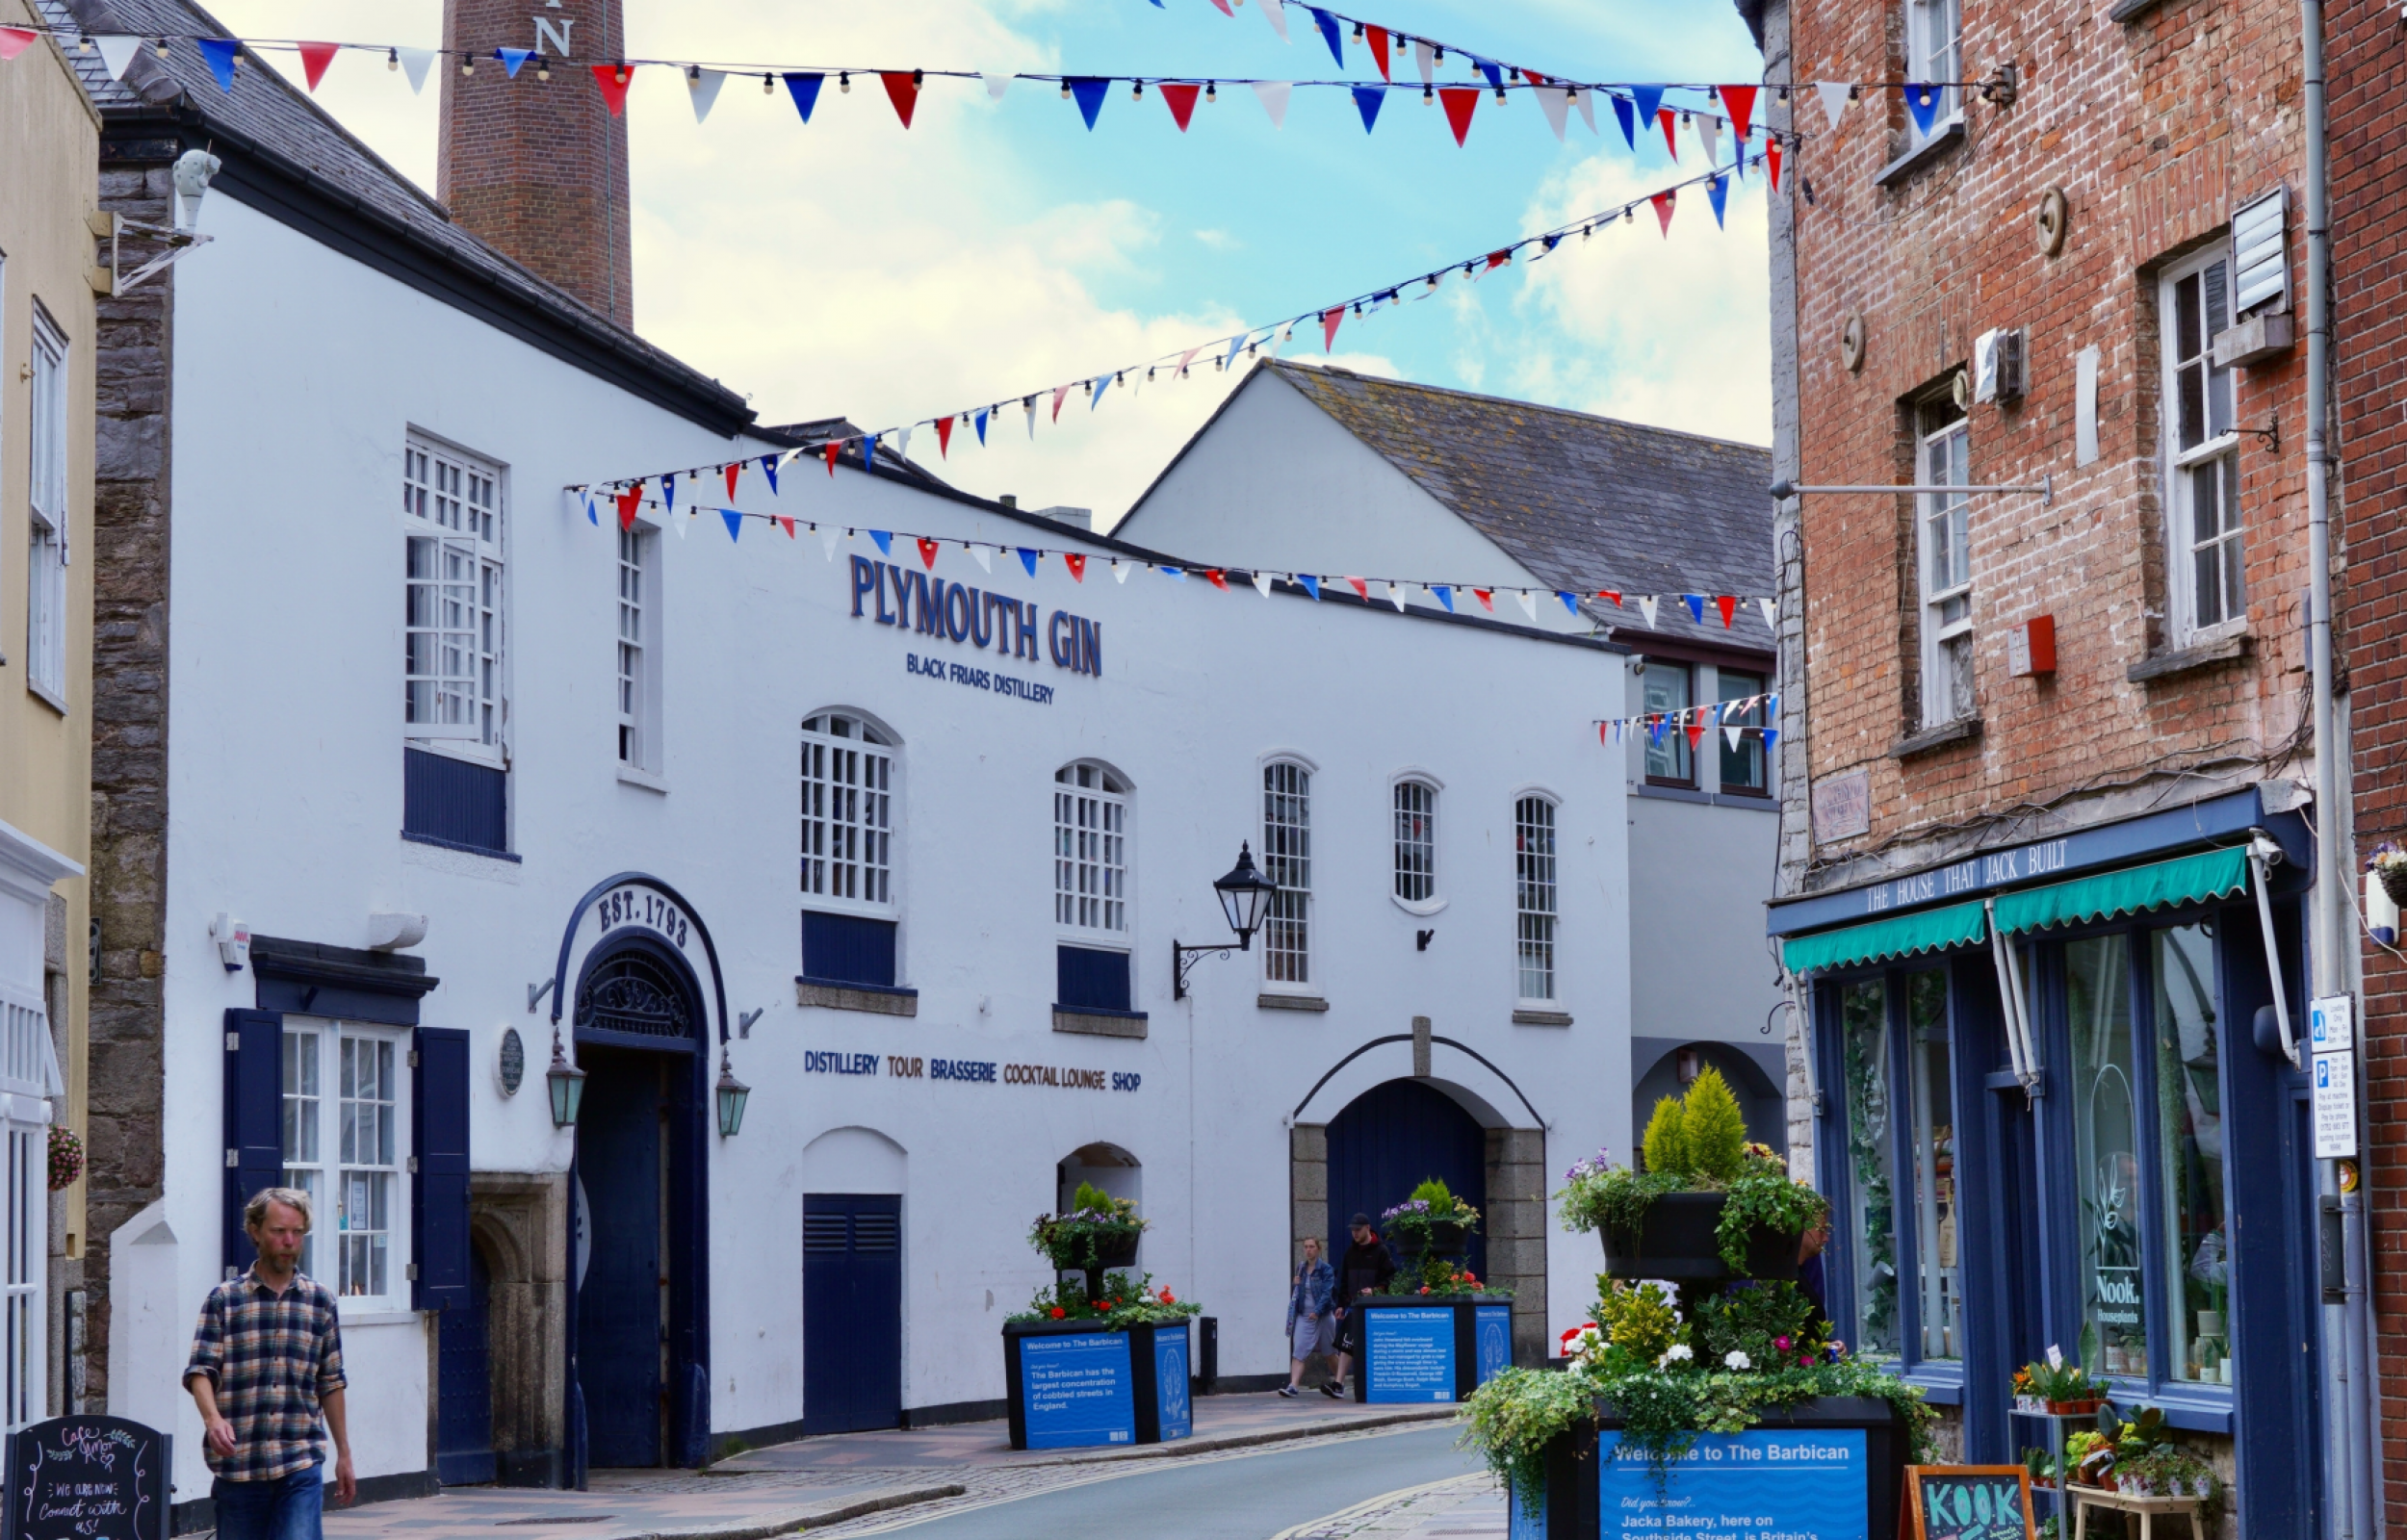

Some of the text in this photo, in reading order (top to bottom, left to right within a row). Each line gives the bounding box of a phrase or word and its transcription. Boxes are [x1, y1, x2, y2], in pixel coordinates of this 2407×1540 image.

[532, 0, 574, 57] N
[850, 553, 1101, 677] PLYMOUTH GIN
[907, 653, 1054, 705] BLACK FRIARS DISTILLERY
[1866, 839, 2067, 912] THE HOUSE THAT JACK BUILT
[599, 891, 687, 948] EST. 1793
[805, 1050, 1141, 1092] DISTILLERY TOUR BRASSERIE COCKTAIL LOUNGE SHOP
[2096, 1275, 2139, 1303] Nook.
[2097, 1308, 2138, 1324] Houseplants
[1026, 1342, 1062, 1350] Welcome
[1073, 1339, 1087, 1348] The
[1089, 1338, 1123, 1347] Barbican
[1048, 1369, 1083, 1379] Barbican
[1101, 1367, 1115, 1375] the
[1031, 1378, 1115, 1391] largest concentration
[1032, 1392, 1041, 1400] of
[1043, 1390, 1074, 1399] cobbled
[1076, 1389, 1103, 1398] streets
[1704, 1446, 1722, 1461] to
[1726, 1444, 1762, 1460] The
[1768, 1444, 1849, 1460] Barbican
[1621, 1497, 1640, 1507] Did
[1927, 1483, 2024, 1527] KOOK
[1621, 1514, 1773, 1529] Jacka Bakery, here on
